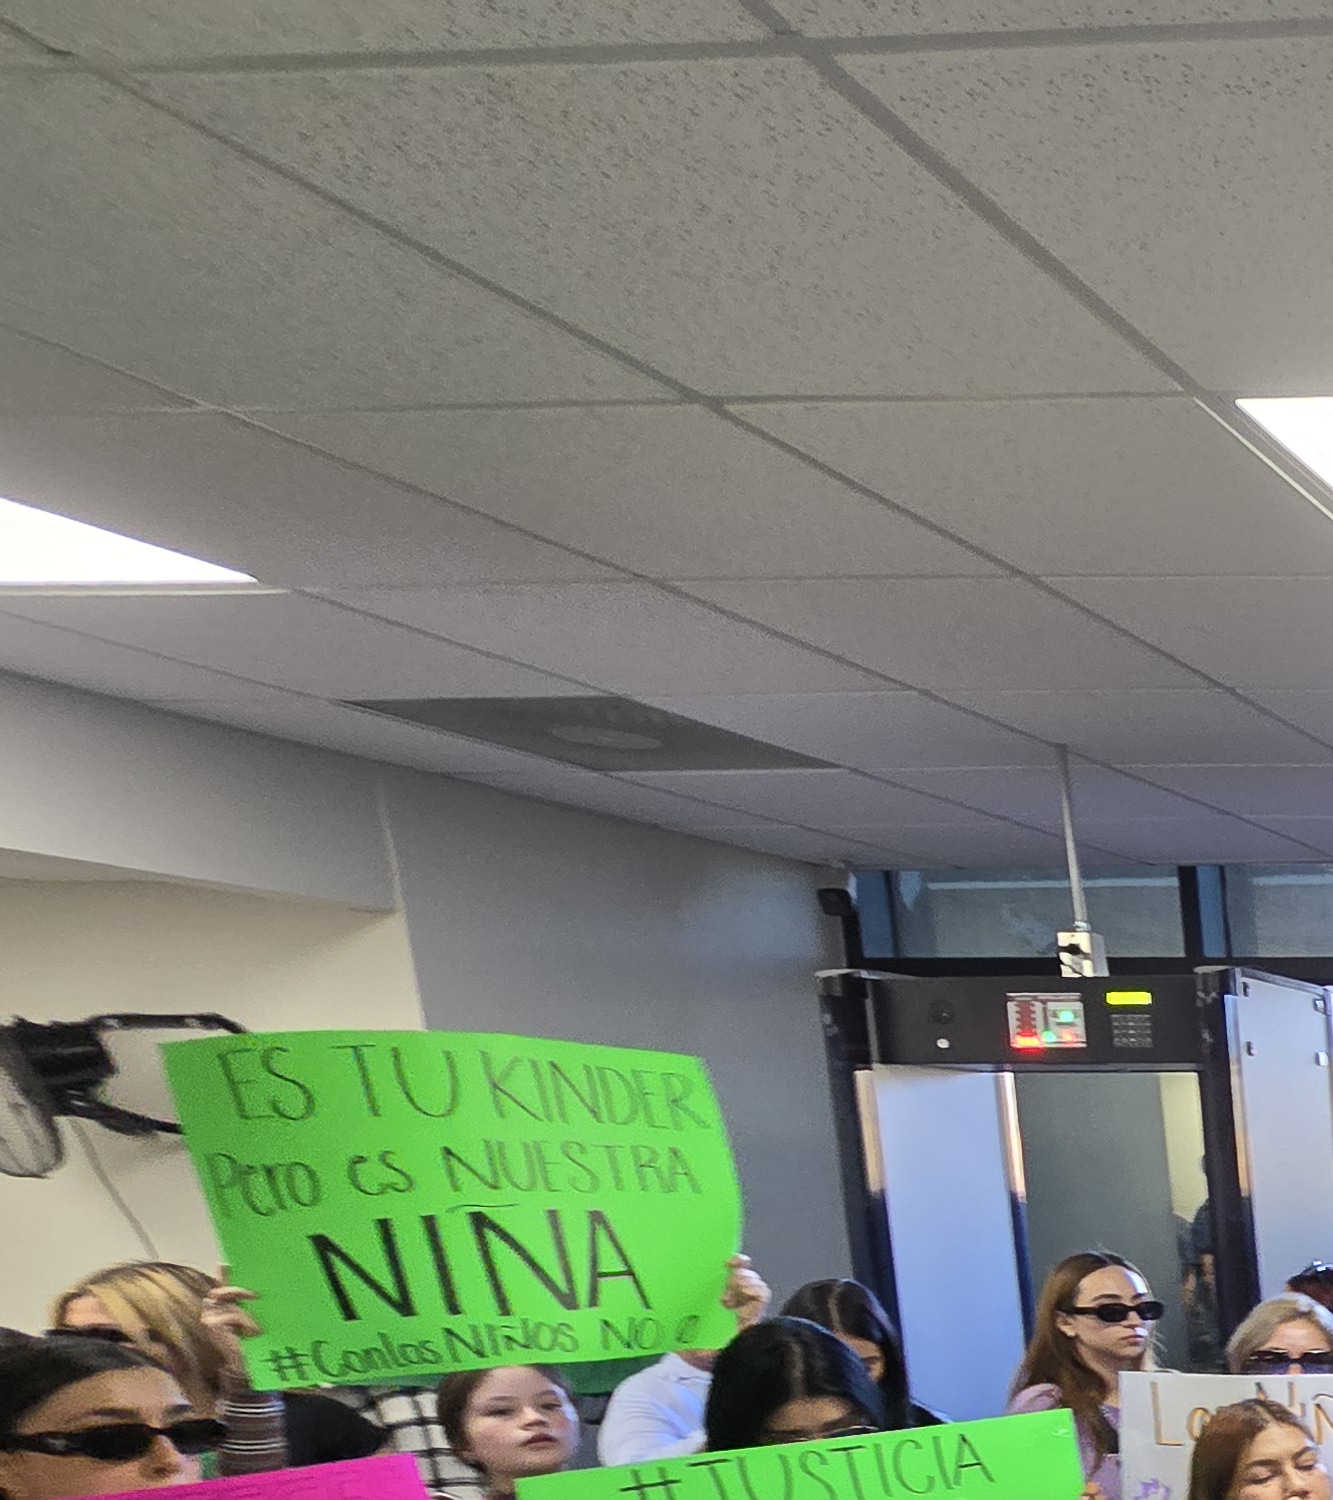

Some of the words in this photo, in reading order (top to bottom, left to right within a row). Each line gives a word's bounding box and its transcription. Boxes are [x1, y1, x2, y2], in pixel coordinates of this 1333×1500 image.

[216, 1047, 314, 1121] ES
[329, 1043, 460, 1118] TU
[481, 1050, 713, 1132] KINDER
[442, 1140, 701, 1195] NUESTRA
[309, 1203, 651, 1321] NIÑA
